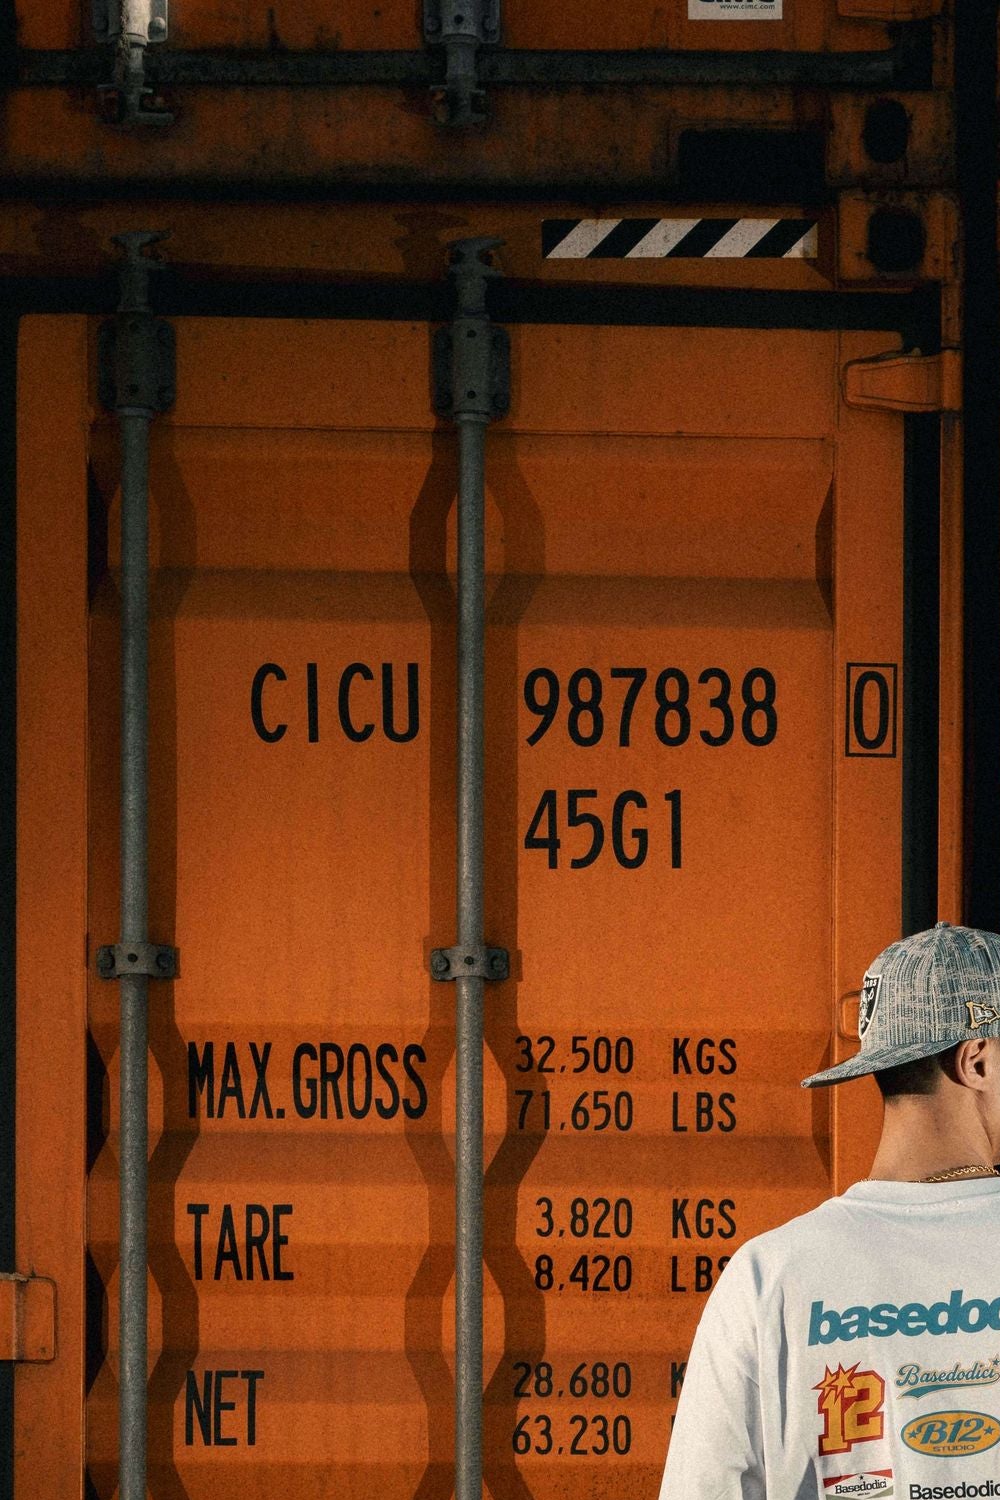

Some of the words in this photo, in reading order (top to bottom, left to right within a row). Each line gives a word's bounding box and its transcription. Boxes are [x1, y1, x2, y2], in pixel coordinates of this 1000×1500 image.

[251, 662, 420, 743] CICU
[523, 667, 778, 747] 987838
[853, 670, 890, 750] 0
[524, 789, 682, 869] 45G1
[673, 1038, 736, 1075] KGS
[673, 1092, 736, 1132] LBS
[187, 1204, 294, 1281] TARE
[535, 1197, 632, 1238] 3,820
[672, 1199, 736, 1238] KGS
[535, 1254, 632, 1292] 8,420
[896, 1362, 1000, 1390] Basedodici
[185, 1370, 264, 1446] NET
[818, 1369, 886, 1457] 12
[916, 1418, 985, 1445] B12
[932, 1444, 976, 1453] STUDIO
[834, 1478, 888, 1495] Basedodici
